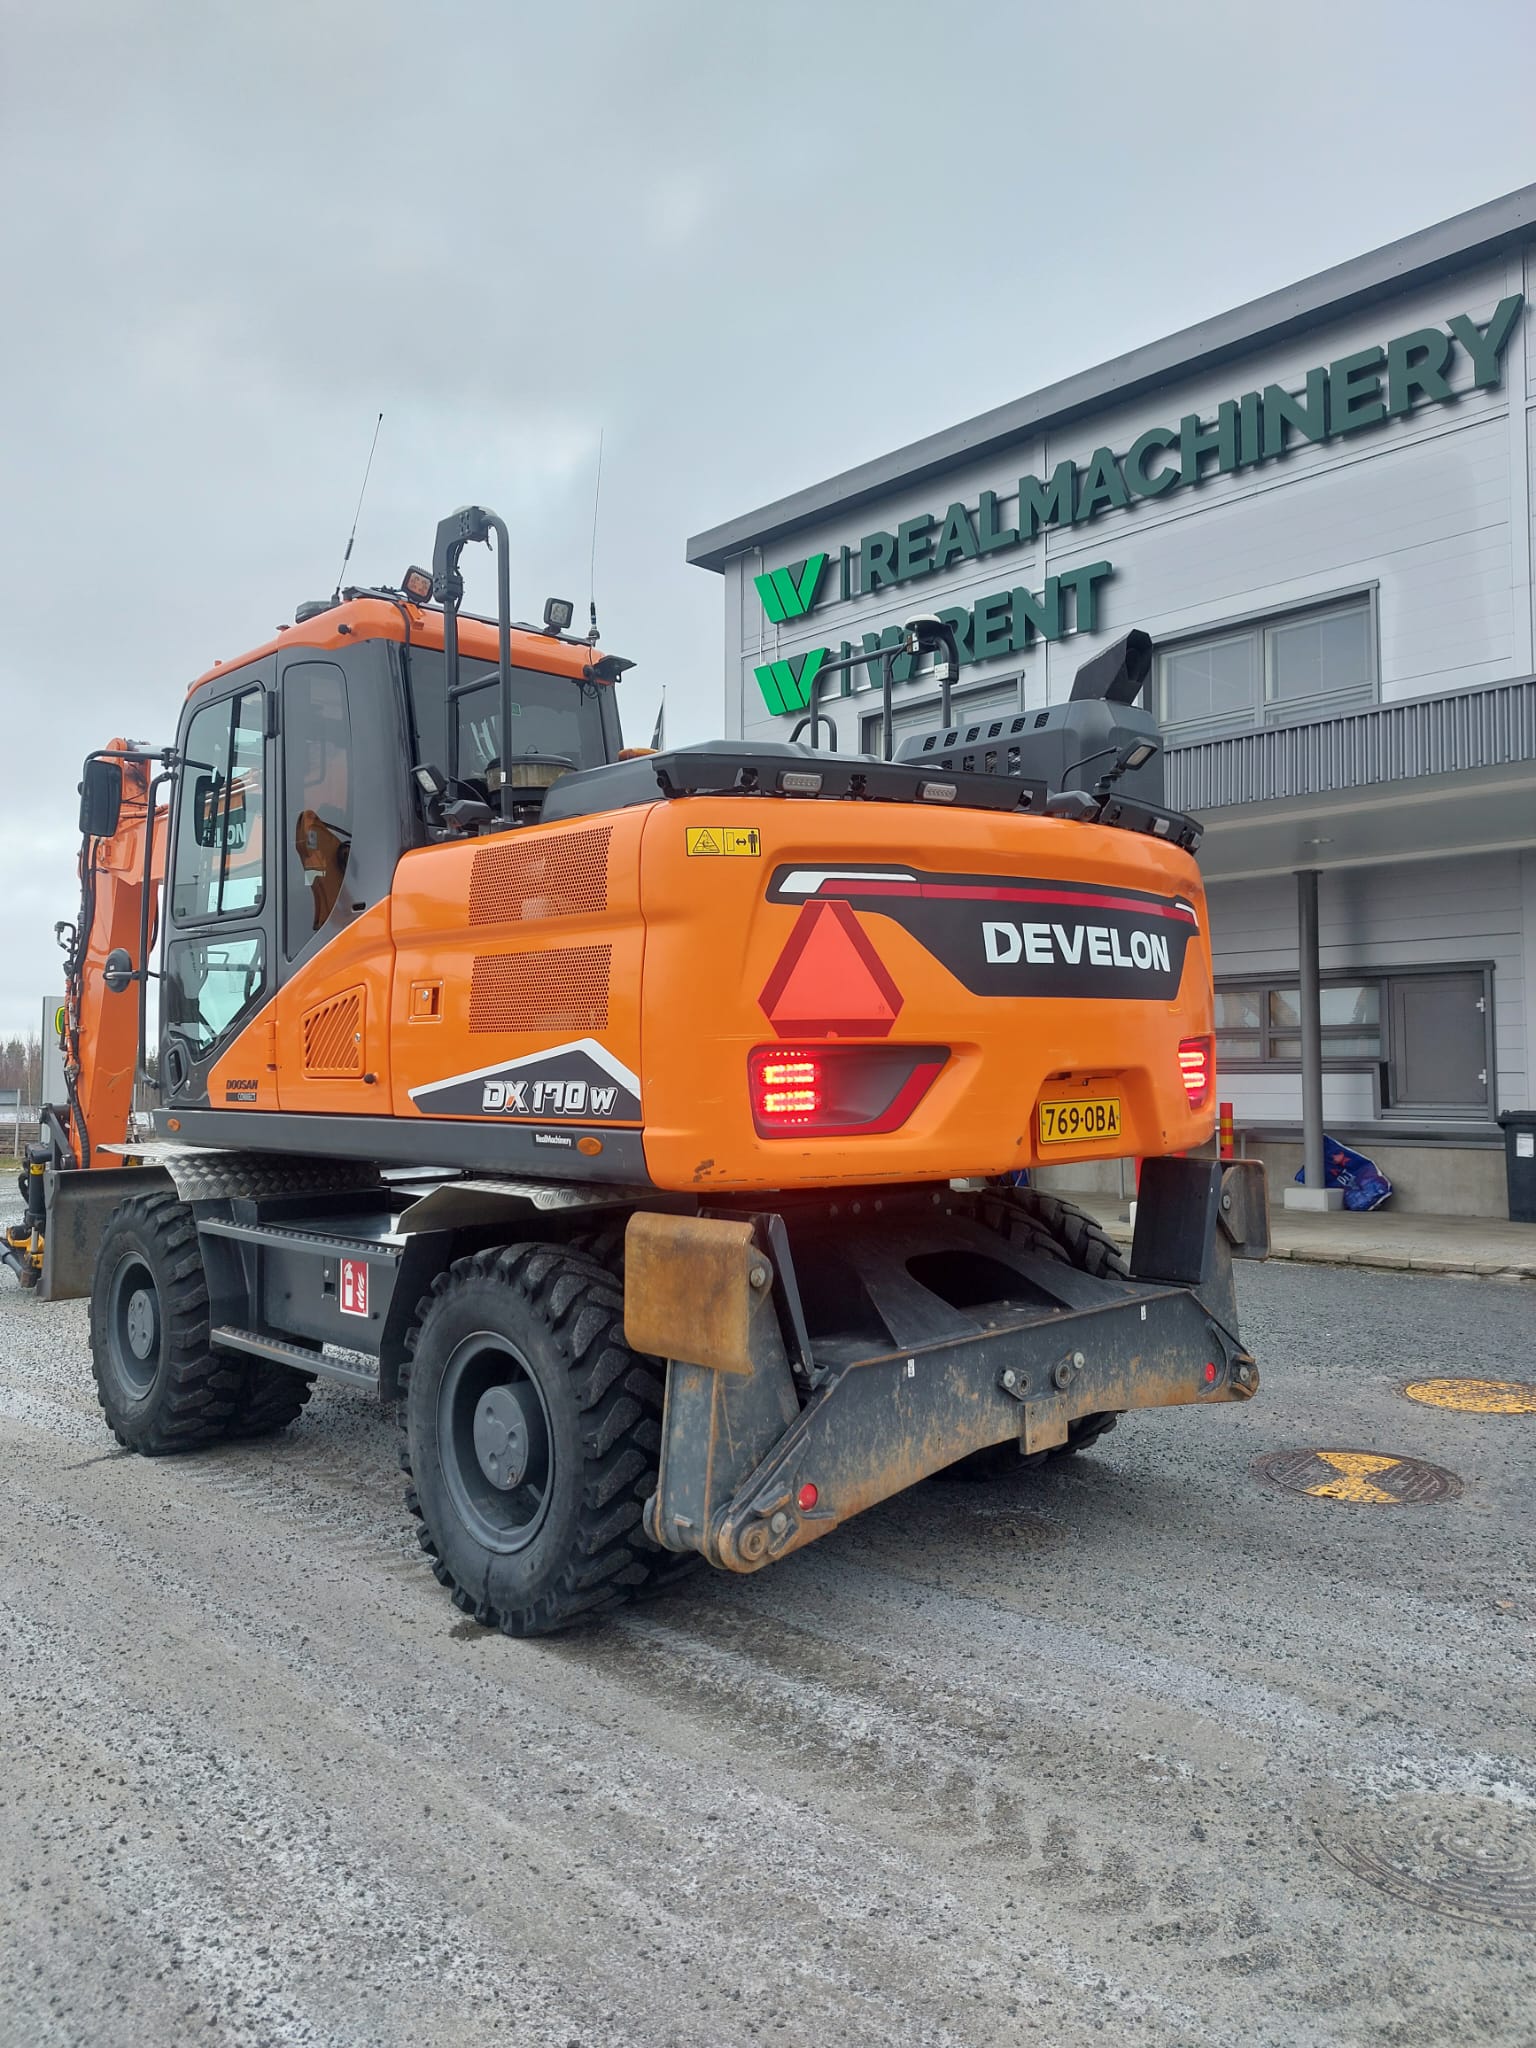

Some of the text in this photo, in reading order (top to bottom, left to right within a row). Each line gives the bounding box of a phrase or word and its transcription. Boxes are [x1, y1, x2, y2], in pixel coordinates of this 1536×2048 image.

[934, 561, 1113, 667] RENT
[982, 922, 1171, 972] DEVELON
[226, 1079, 259, 1090] DOOSAN
[482, 1081, 529, 1113] DX
